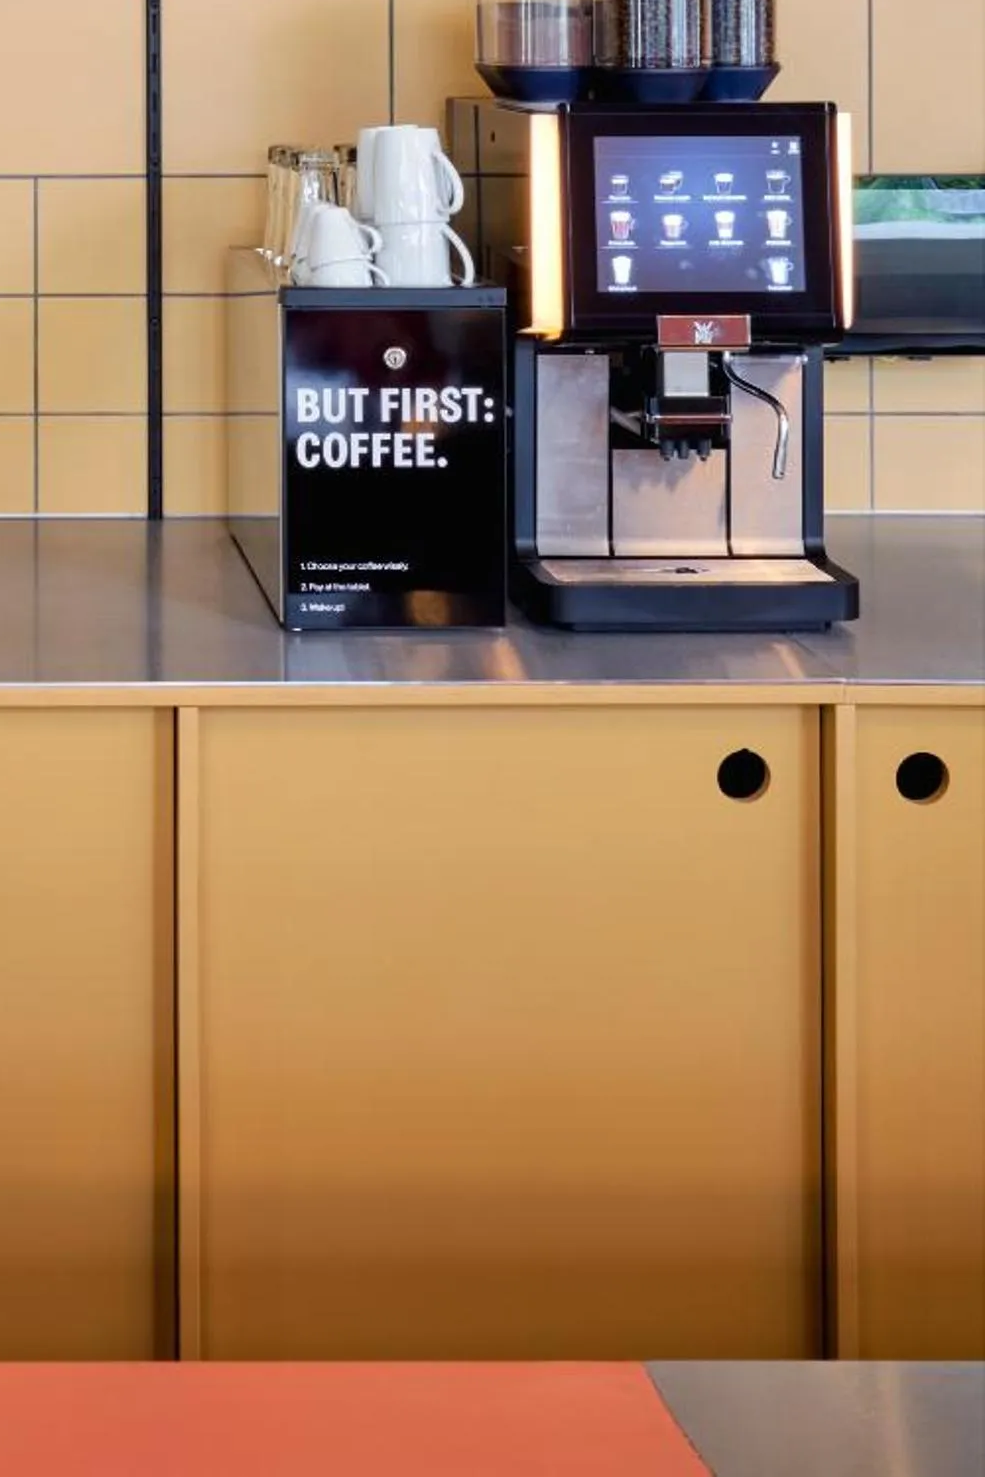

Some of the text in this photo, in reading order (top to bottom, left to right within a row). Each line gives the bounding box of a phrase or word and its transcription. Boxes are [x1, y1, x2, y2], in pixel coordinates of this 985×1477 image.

[297, 387, 494, 422] BUT FIRST:
[296, 432, 448, 468] COFFEE.
